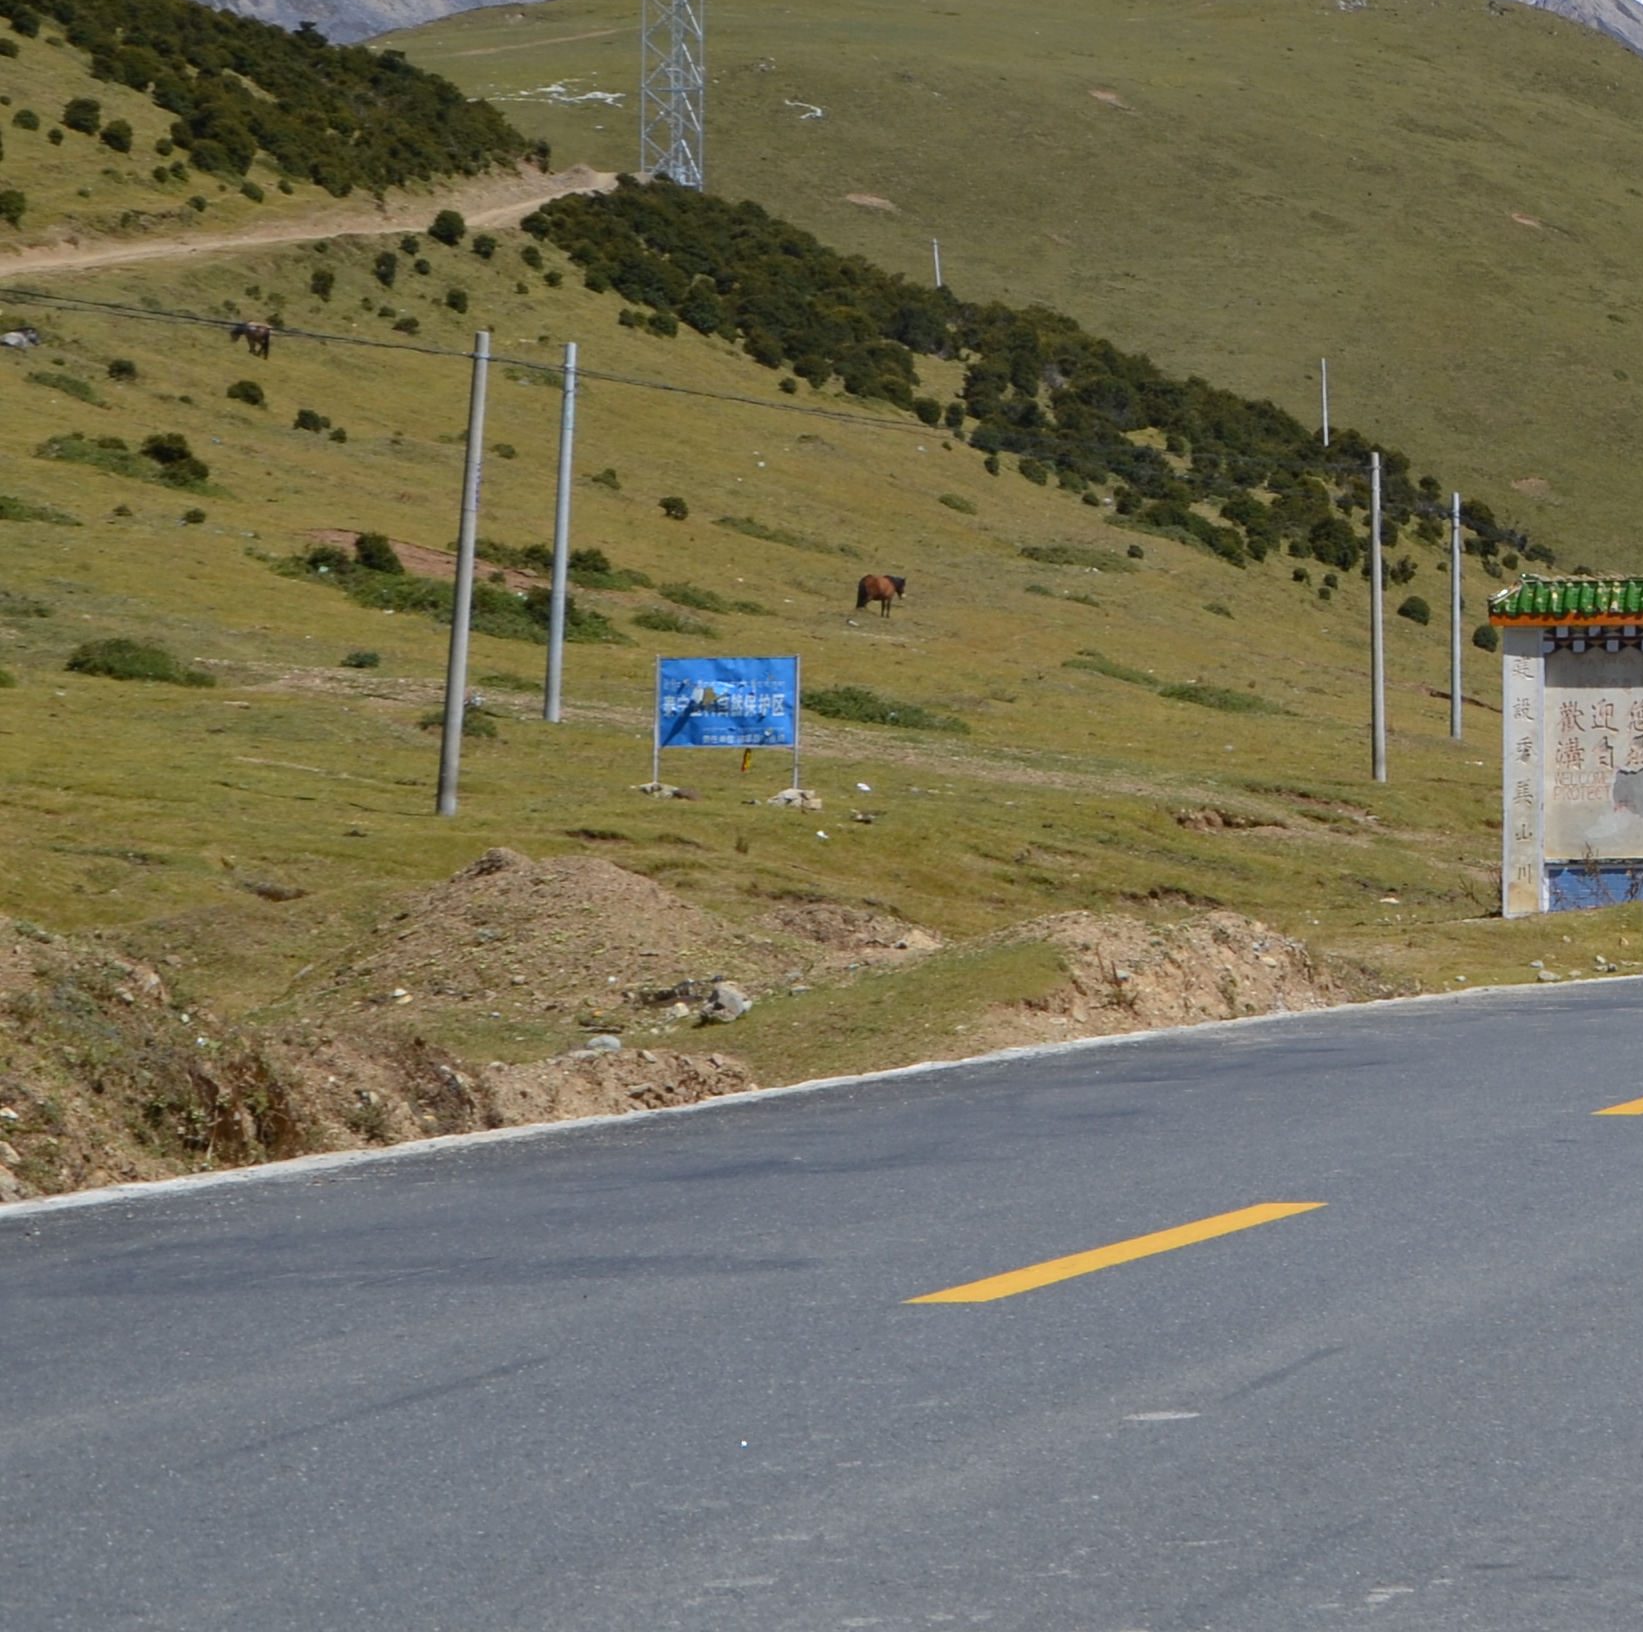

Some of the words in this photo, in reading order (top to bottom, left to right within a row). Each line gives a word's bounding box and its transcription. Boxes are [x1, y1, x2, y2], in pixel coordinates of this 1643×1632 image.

[663, 693, 786, 717] 泰宁自然保护区
[1554, 785, 1611, 800] PROTECT
